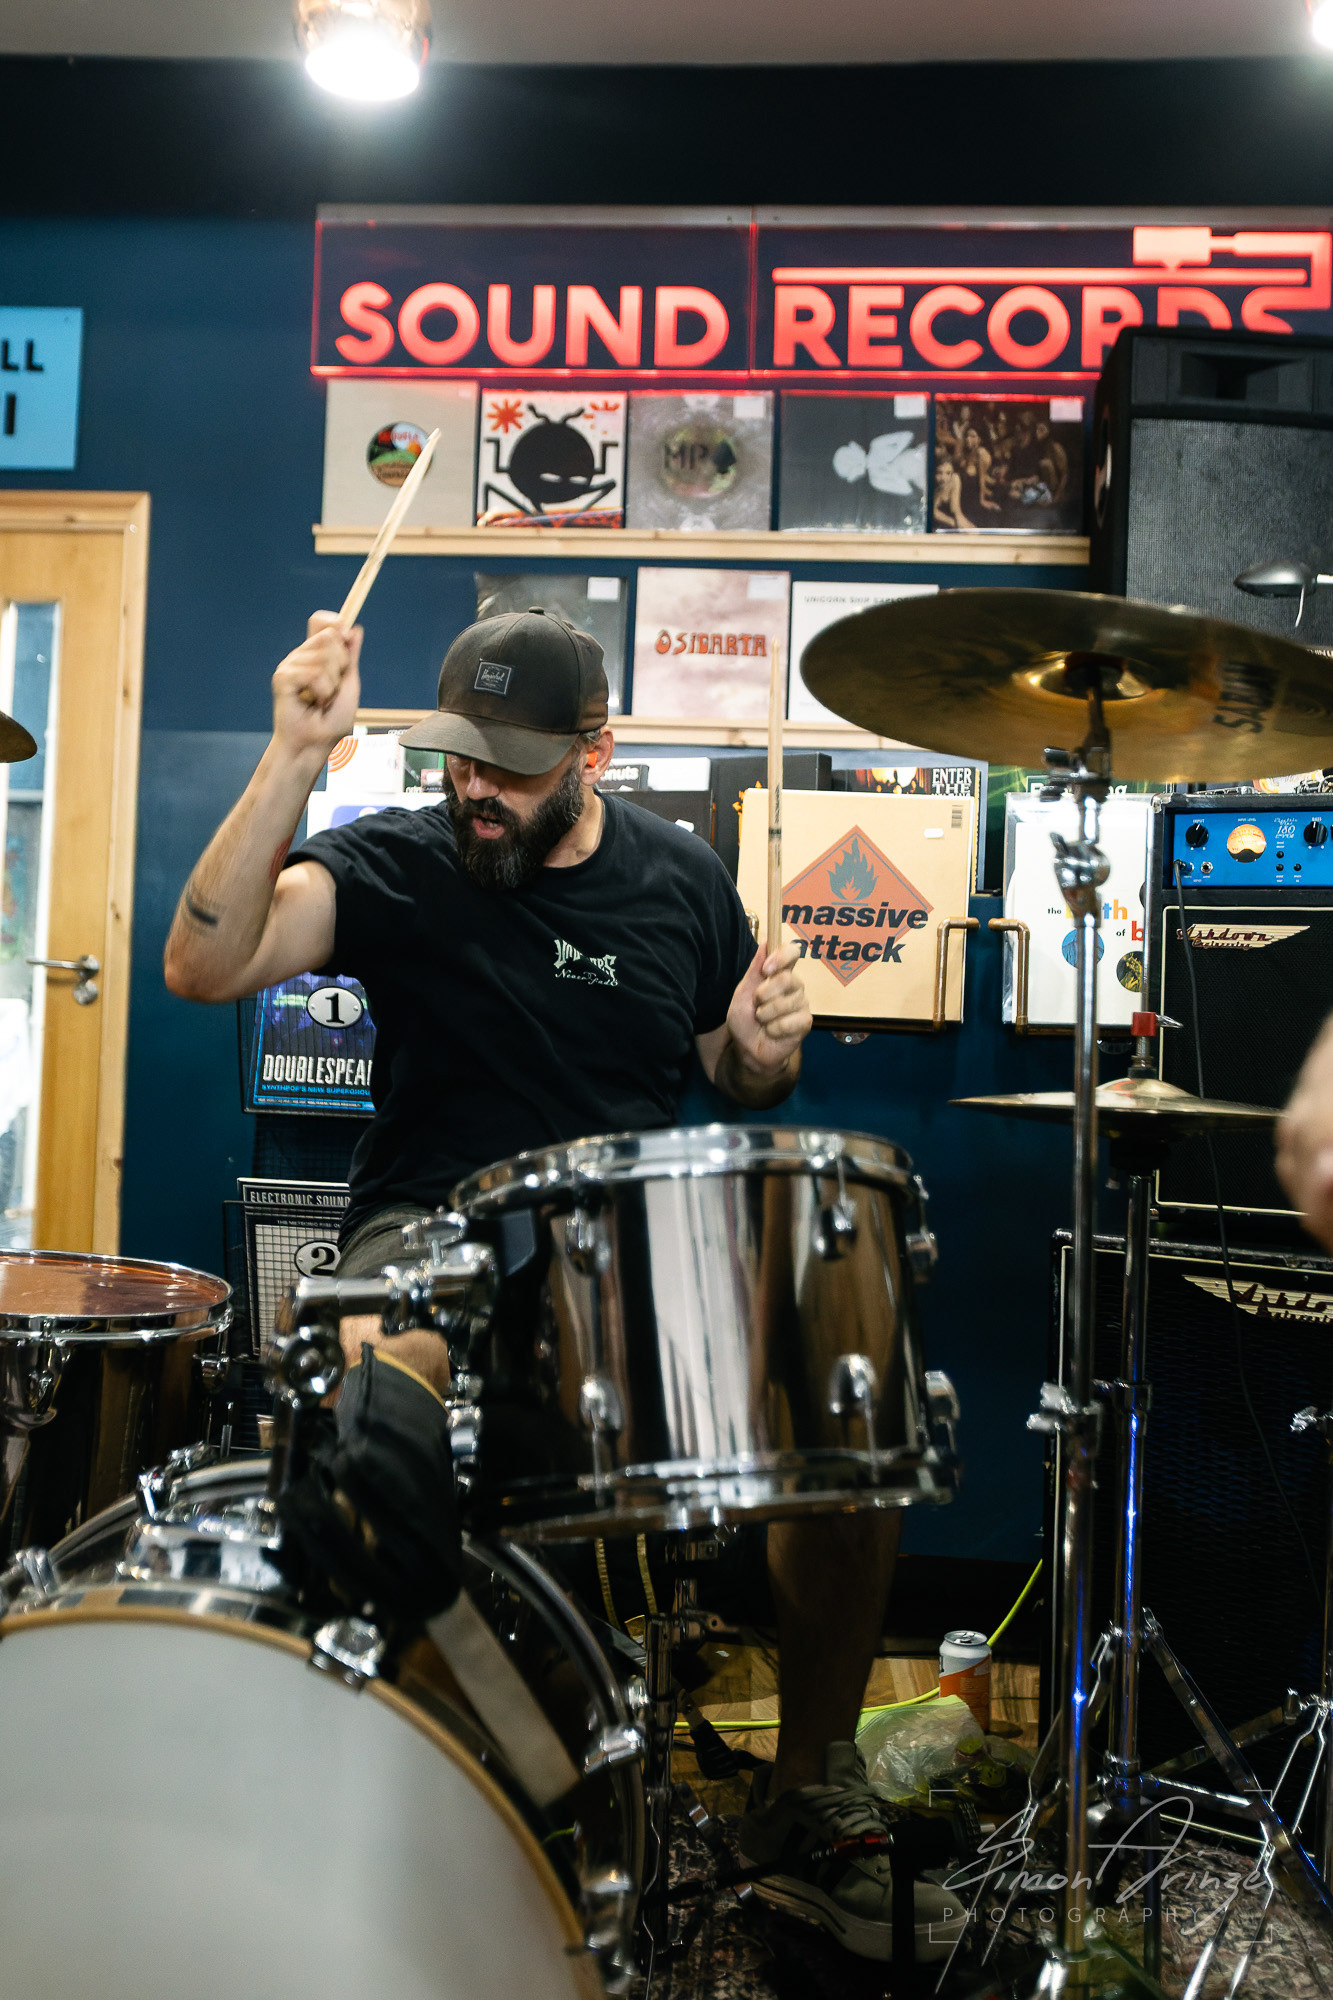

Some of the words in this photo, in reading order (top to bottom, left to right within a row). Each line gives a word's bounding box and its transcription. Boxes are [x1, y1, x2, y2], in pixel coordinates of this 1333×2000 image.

[335, 281, 729, 366] SOUND
[600, 765, 639, 782] onuts
[932, 767, 972, 784] ENTER
[932, 783, 971, 794] THE
[782, 902, 929, 929] massive
[1047, 907, 1062, 915] the
[1116, 929, 1127, 937] of
[1176, 924, 1272, 942] Ashdown
[791, 934, 906, 963] attack
[325, 993, 345, 1024] 1
[308, 1086, 325, 1094] NEW
[326, 1088, 370, 1096] SUPERGROU
[250, 1191, 313, 1205] ELECTRONIC
[316, 1195, 350, 1207] SOUND
[310, 1247, 335, 1276] 2
[1231, 1282, 1333, 1313] Ashdo
